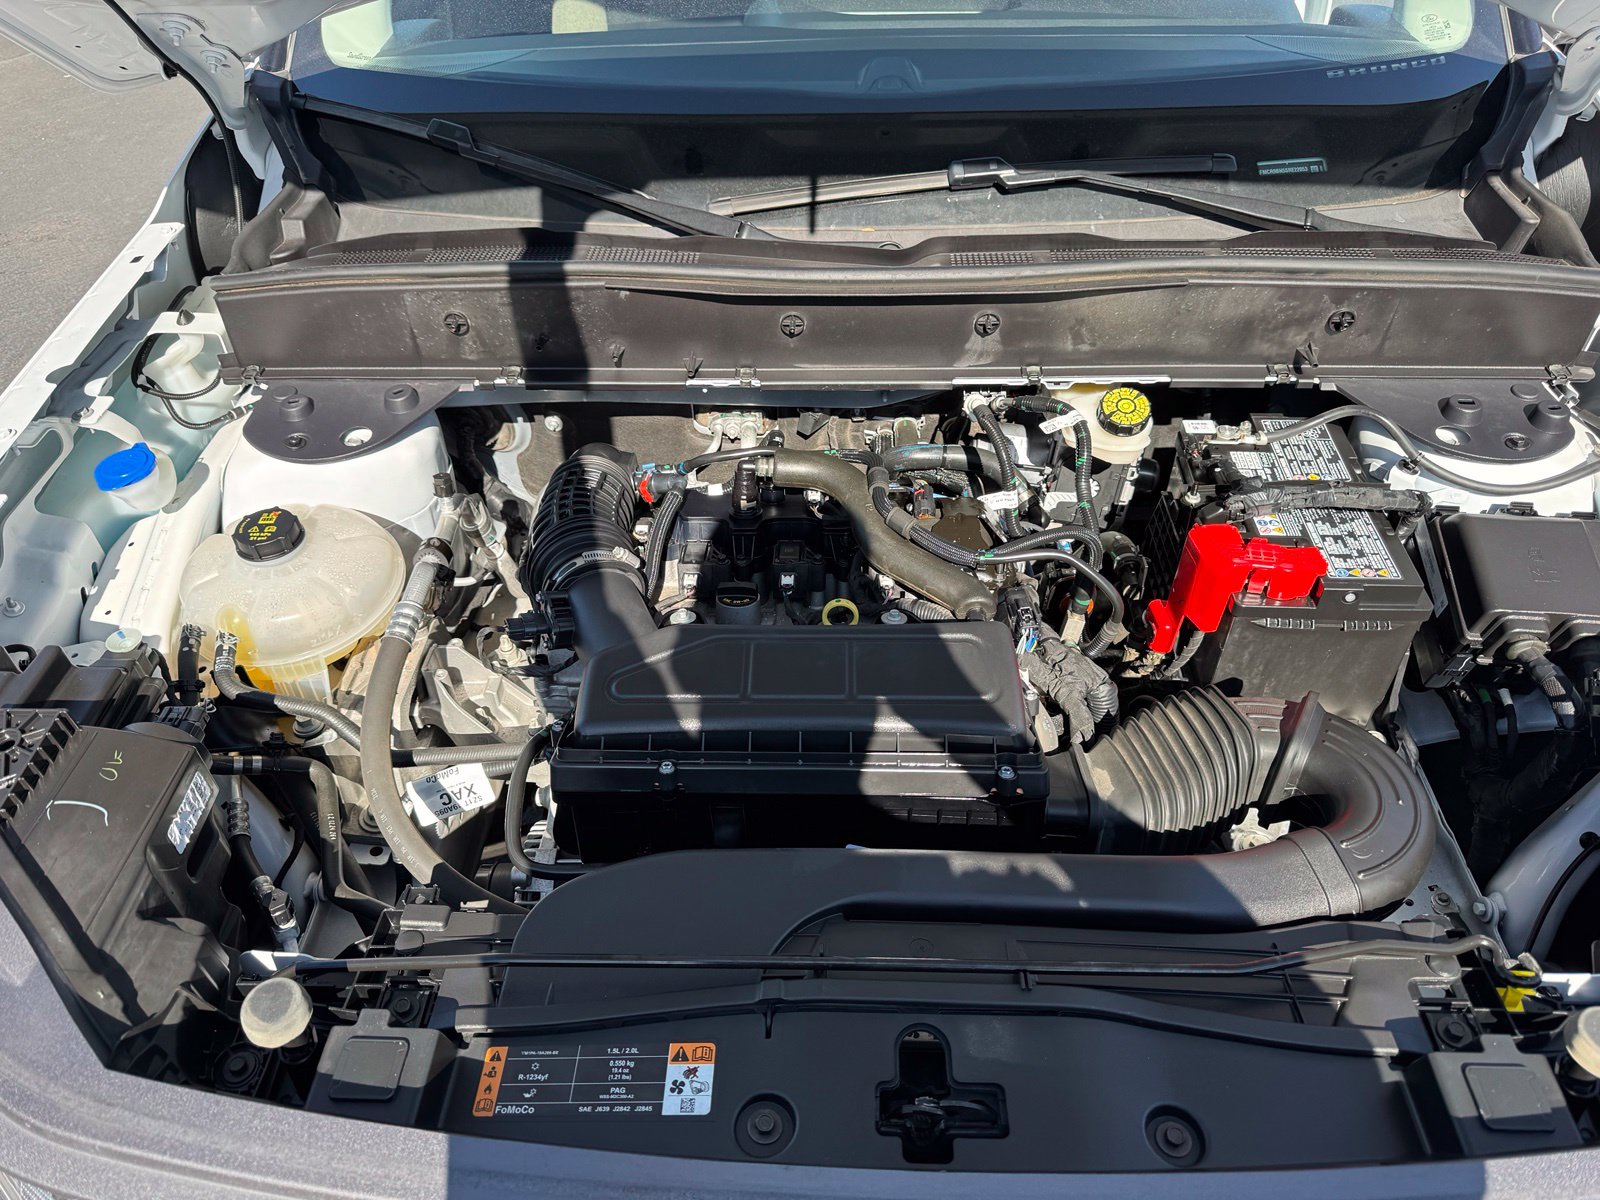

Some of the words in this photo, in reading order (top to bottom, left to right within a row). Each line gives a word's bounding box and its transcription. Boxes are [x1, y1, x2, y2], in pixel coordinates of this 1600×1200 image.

[426, 767, 460, 783] FoMoCo
[440, 783, 477, 806] XAC
[627, 1060, 635, 1068] kg
[518, 1073, 548, 1082] R-1234yf
[494, 1105, 535, 1115] FoMoCo
